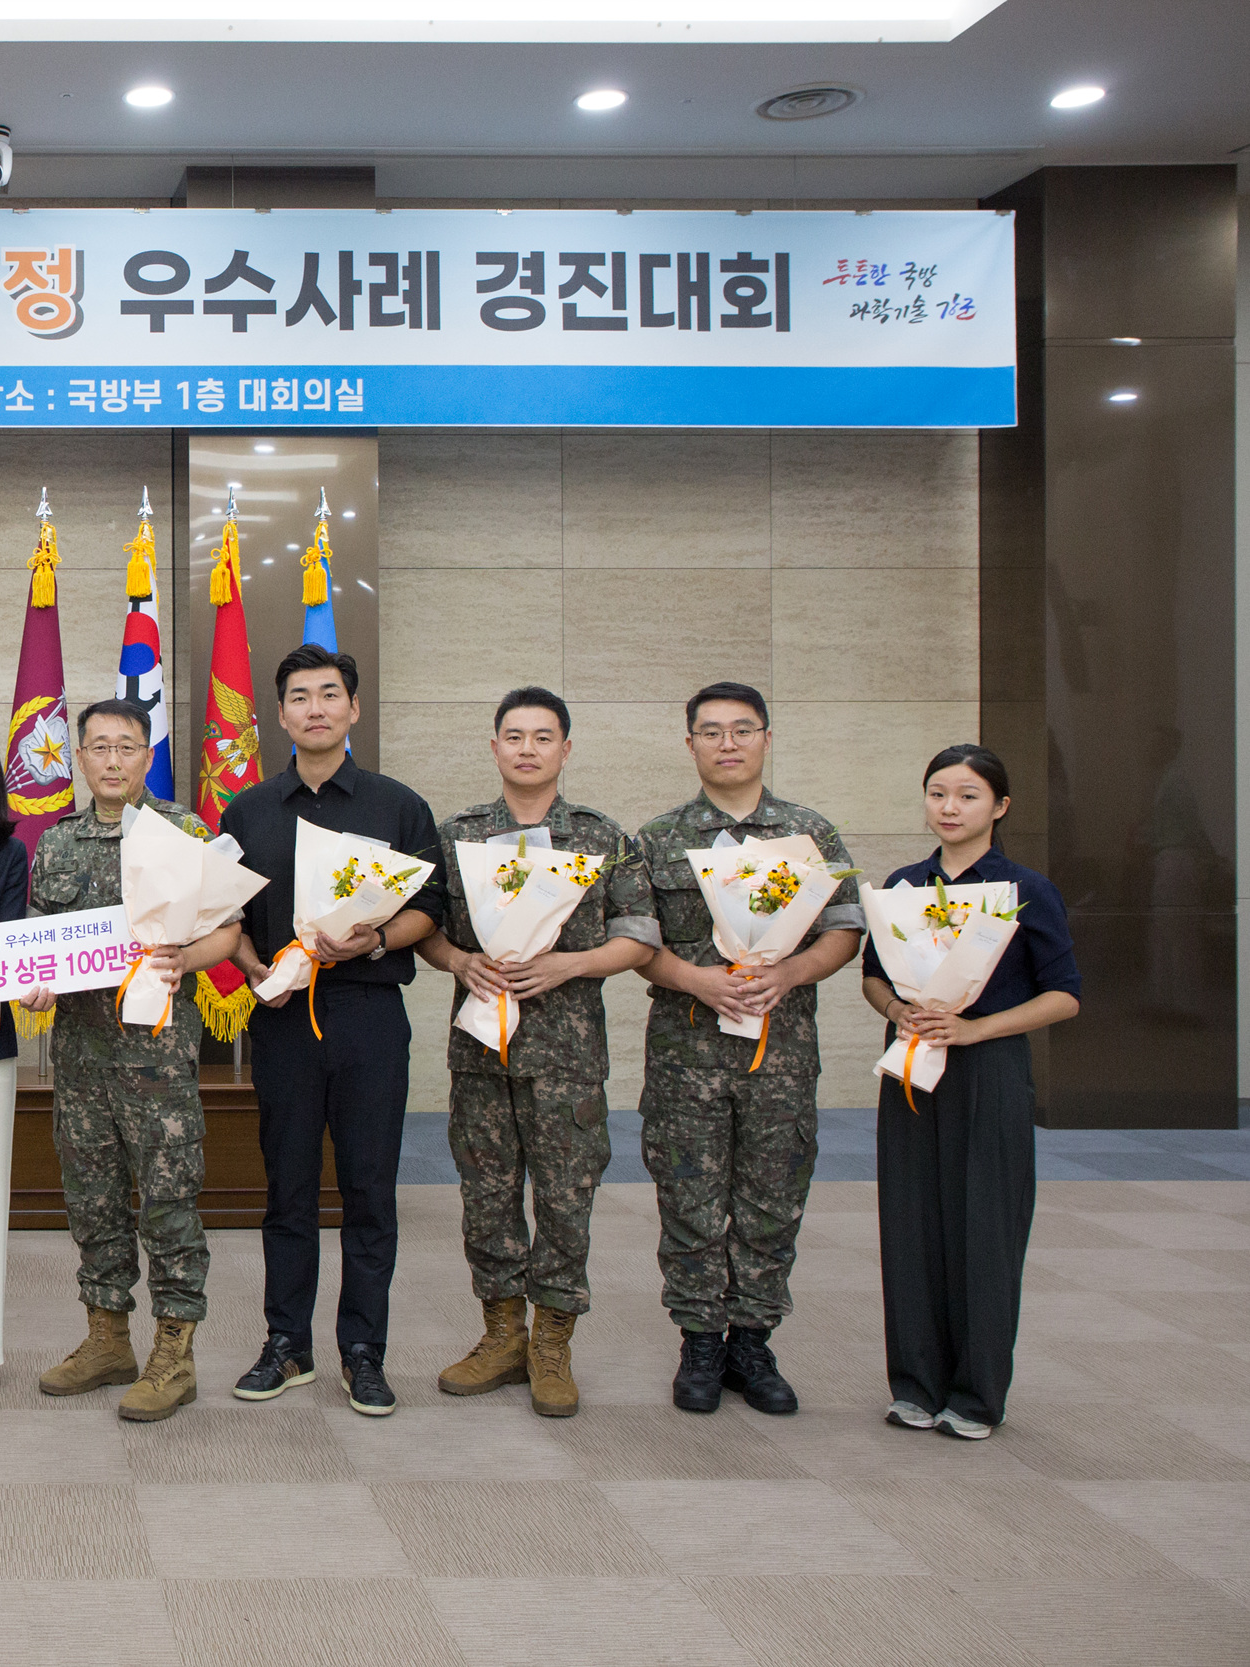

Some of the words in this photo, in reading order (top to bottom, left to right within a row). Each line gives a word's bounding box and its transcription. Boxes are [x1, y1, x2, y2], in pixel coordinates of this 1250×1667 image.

[822, 258, 891, 286] 튼튼한
[899, 261, 938, 290] 국방
[120, 249, 441, 333] 우수사례
[476, 251, 790, 332] 경진대회
[849, 294, 928, 324] 과학기술
[936, 293, 977, 320] 강군
[67, 378, 163, 413] 국방부
[176, 377, 226, 413] 1층
[238, 377, 365, 412] 대회의실
[5, 928, 56, 949] 우수사례
[61, 919, 113, 941] 경진대회
[14, 954, 58, 985] 상금
